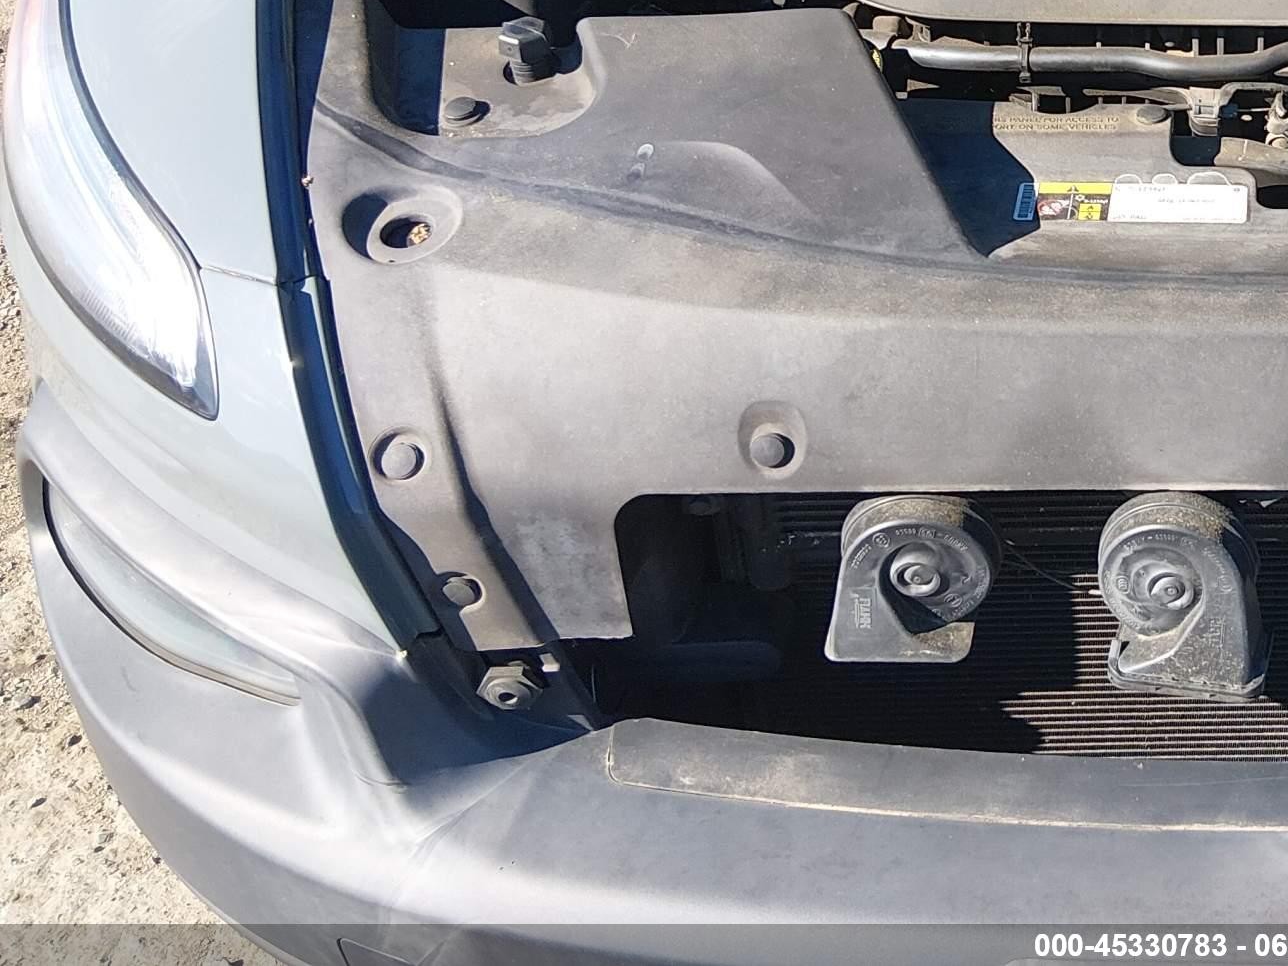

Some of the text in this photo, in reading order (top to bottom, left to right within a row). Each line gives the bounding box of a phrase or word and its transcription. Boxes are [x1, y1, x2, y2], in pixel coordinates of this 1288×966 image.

[1009, 116, 1040, 124] PANEL
[1043, 116, 1062, 124] FOR
[1065, 116, 1104, 124] ACCESS
[1107, 116, 1120, 124] TO
[1019, 123, 1034, 131] ON
[1037, 123, 1063, 131] SOME
[1066, 123, 1117, 131] VEHICLES
